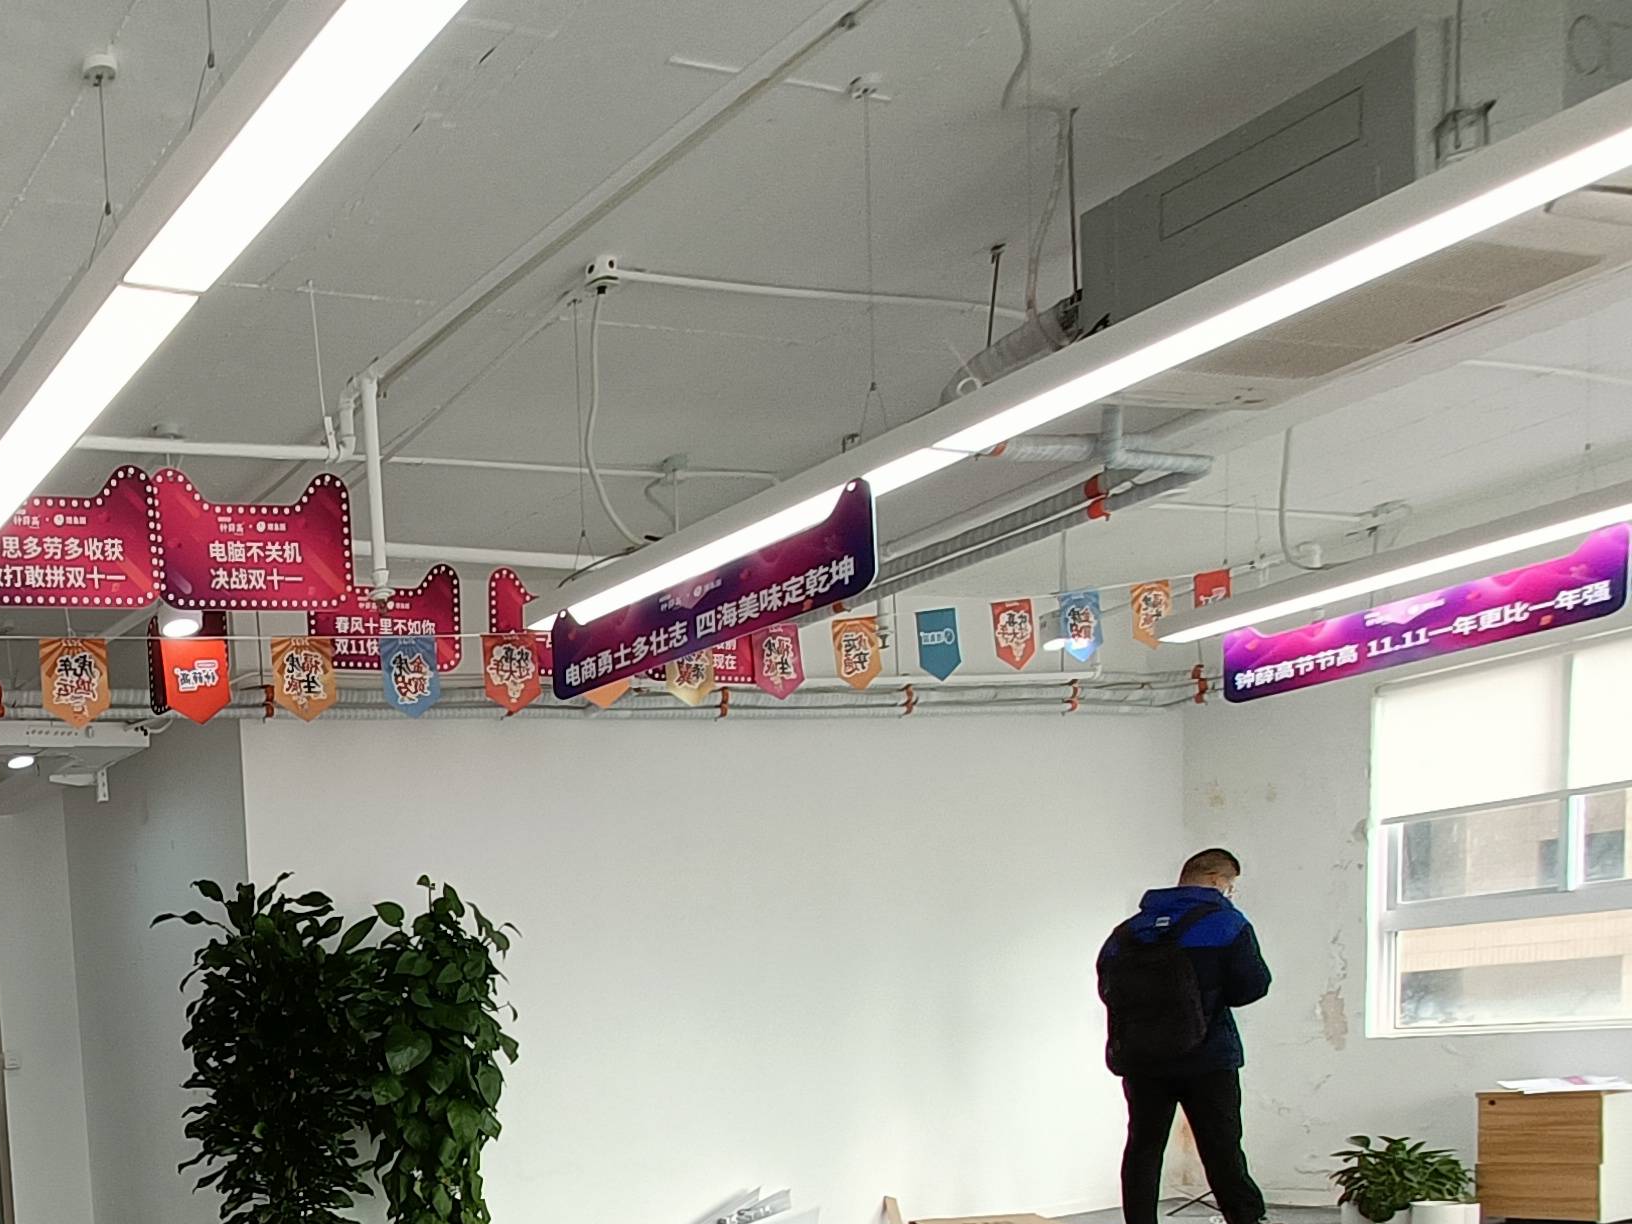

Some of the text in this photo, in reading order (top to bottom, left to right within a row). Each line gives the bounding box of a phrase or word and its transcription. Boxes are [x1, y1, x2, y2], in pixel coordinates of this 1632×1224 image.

[209, 540, 303, 563] 电脑不关机
[210, 567, 303, 590] 决战双十一
[336, 616, 436, 635] 春风十里不如你
[566, 553, 856, 687] 电商勇士多壮志 四海美味定乾坤
[1234, 579, 1611, 691] 钟薛高节节高 11.11一年更比一年强
